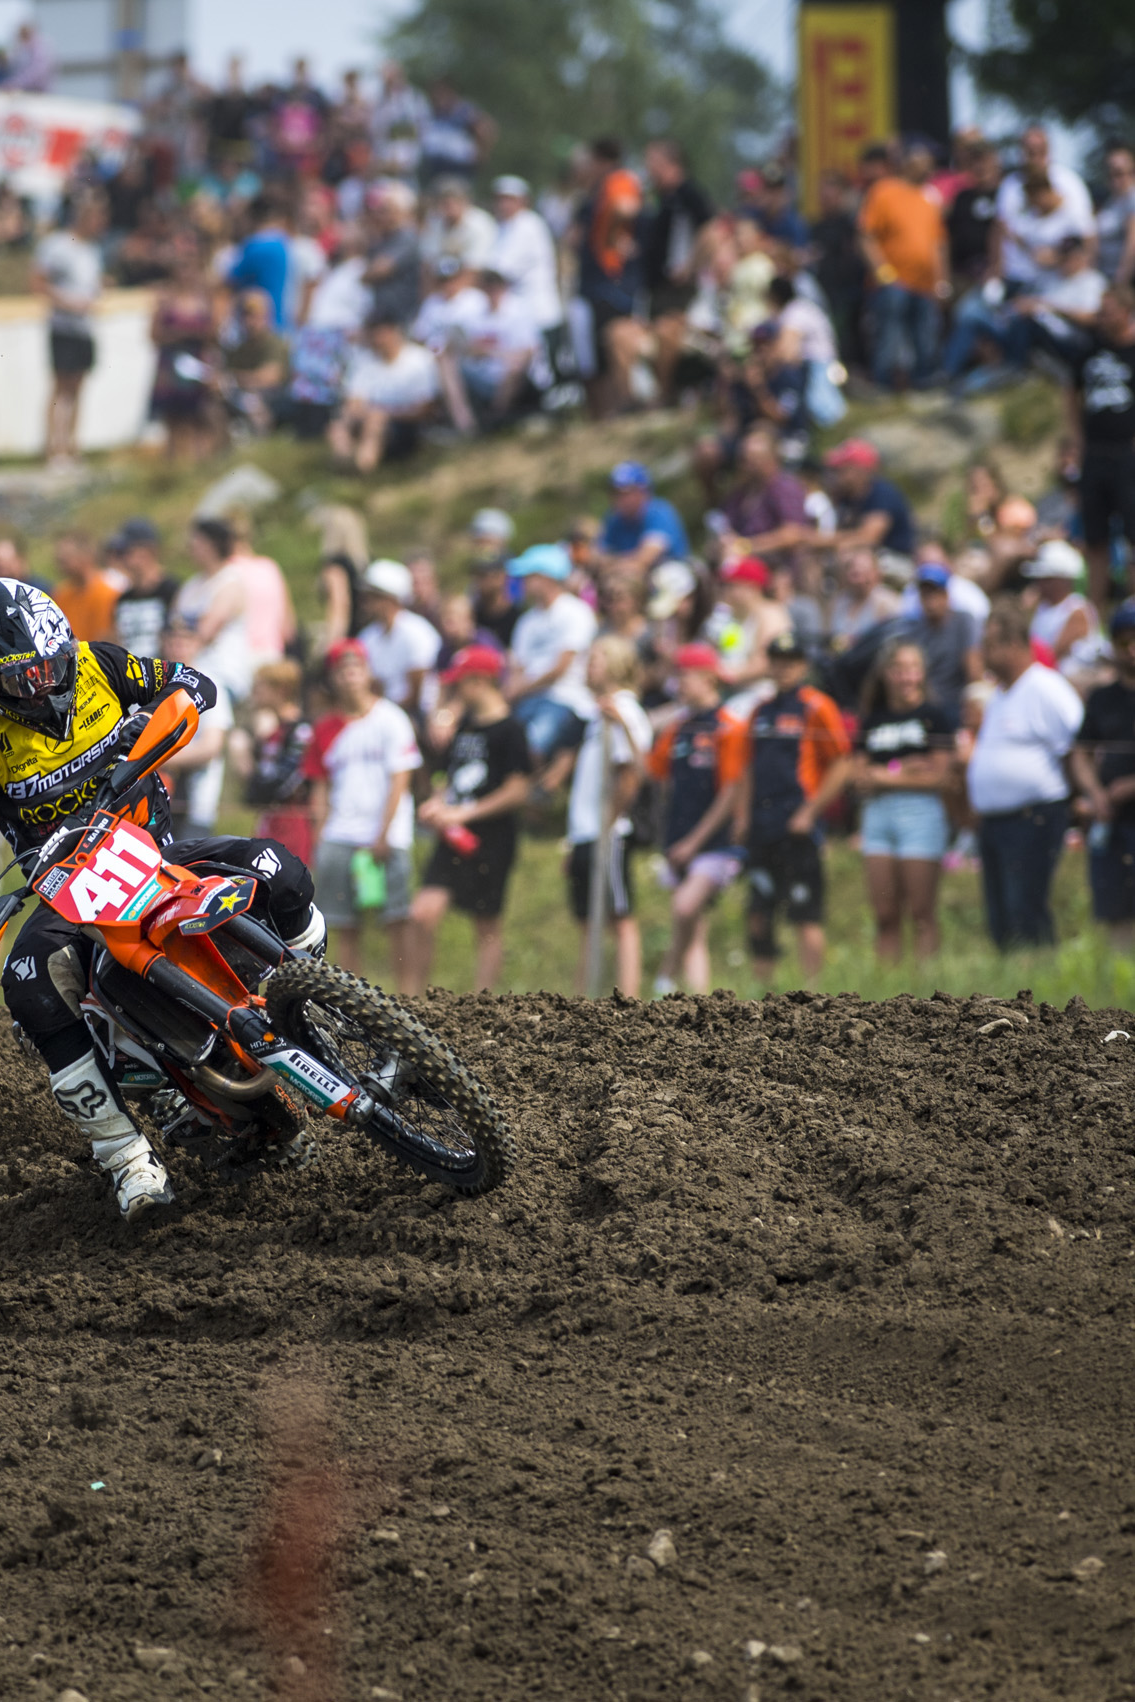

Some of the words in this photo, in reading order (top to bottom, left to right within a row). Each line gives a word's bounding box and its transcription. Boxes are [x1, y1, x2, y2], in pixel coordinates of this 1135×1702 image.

[69, 827, 163, 922] 411
[132, 882, 160, 913] MOTOREX
[288, 1051, 341, 1094] PIRELLI
[288, 1074, 325, 1107] MOTOREX
